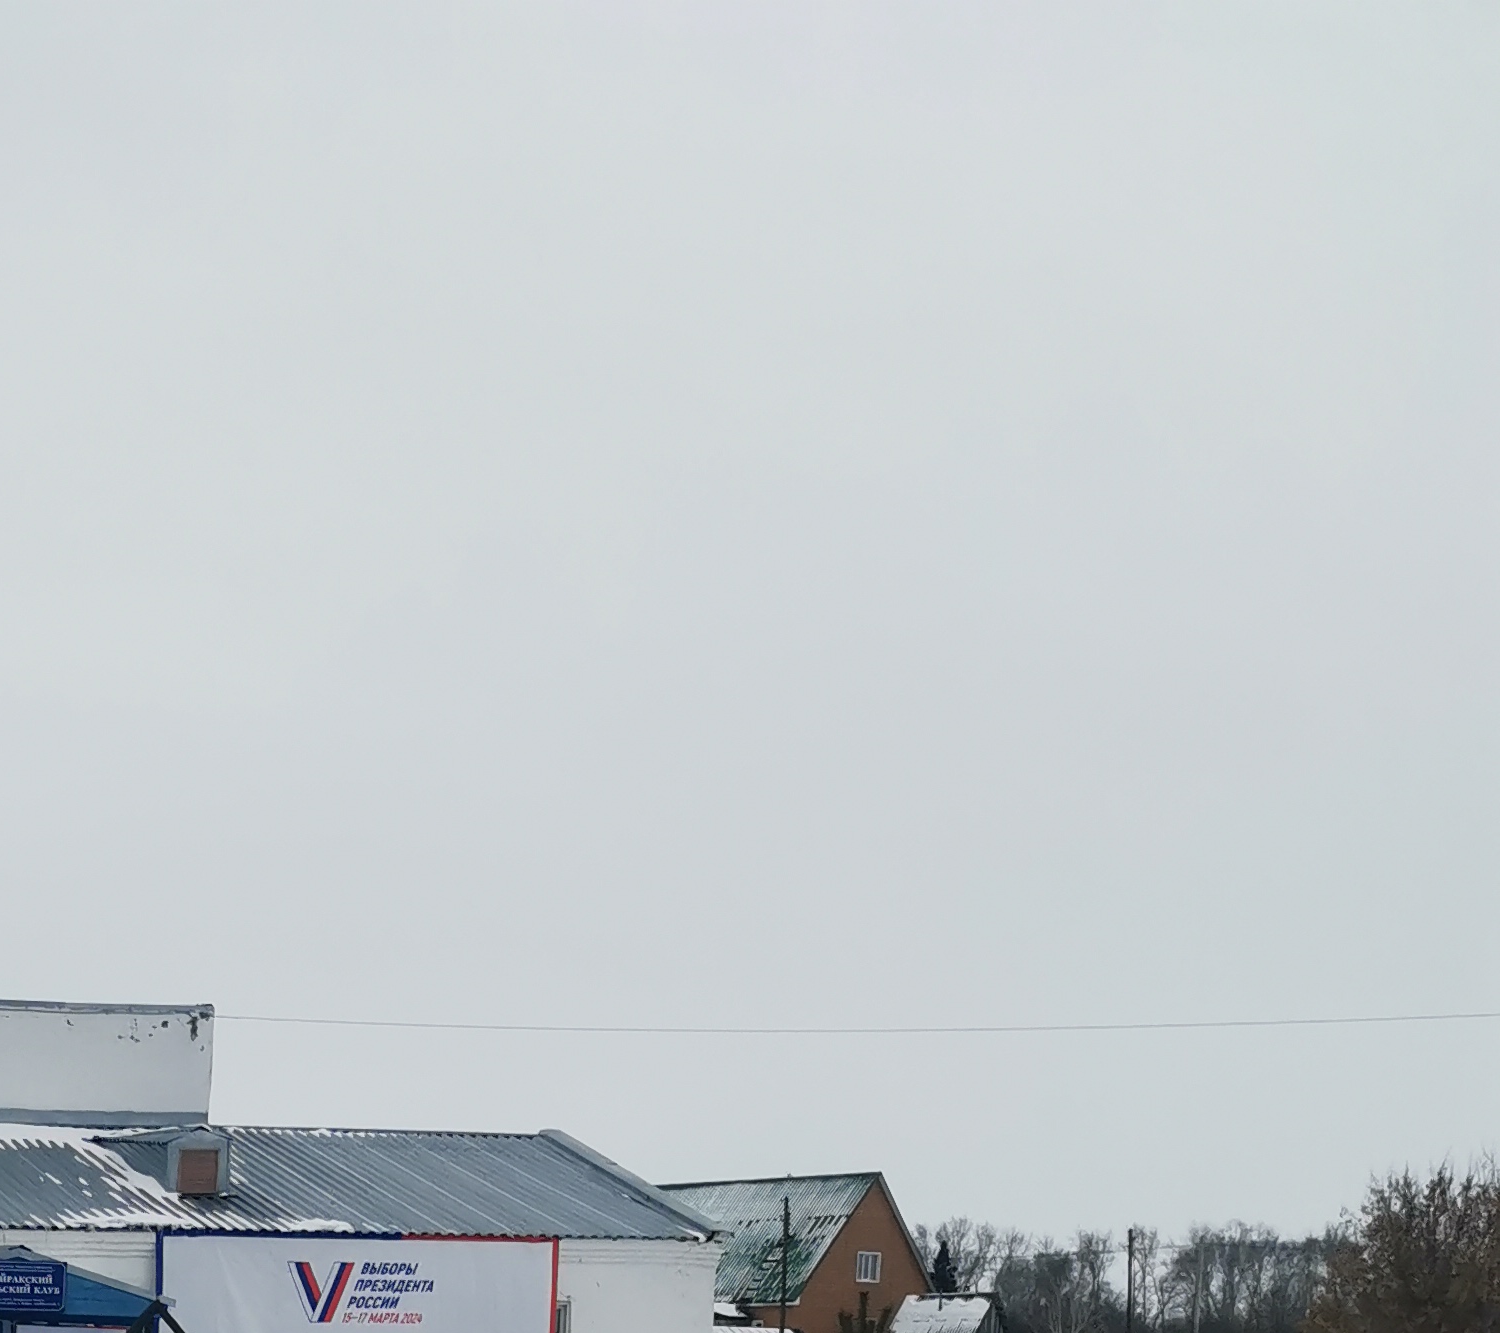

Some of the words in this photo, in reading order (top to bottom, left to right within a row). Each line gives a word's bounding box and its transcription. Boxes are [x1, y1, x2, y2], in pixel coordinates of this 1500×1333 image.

[361, 1262, 419, 1275] ВЫБОРЫ
[33, 1286, 60, 1295] КЛУБ
[353, 1279, 435, 1293] ПРЕЗИДЕНТА
[347, 1296, 400, 1309] РОССИИ
[368, 1312, 399, 1324] МАРТА
[400, 1312, 423, 1324] 2024
